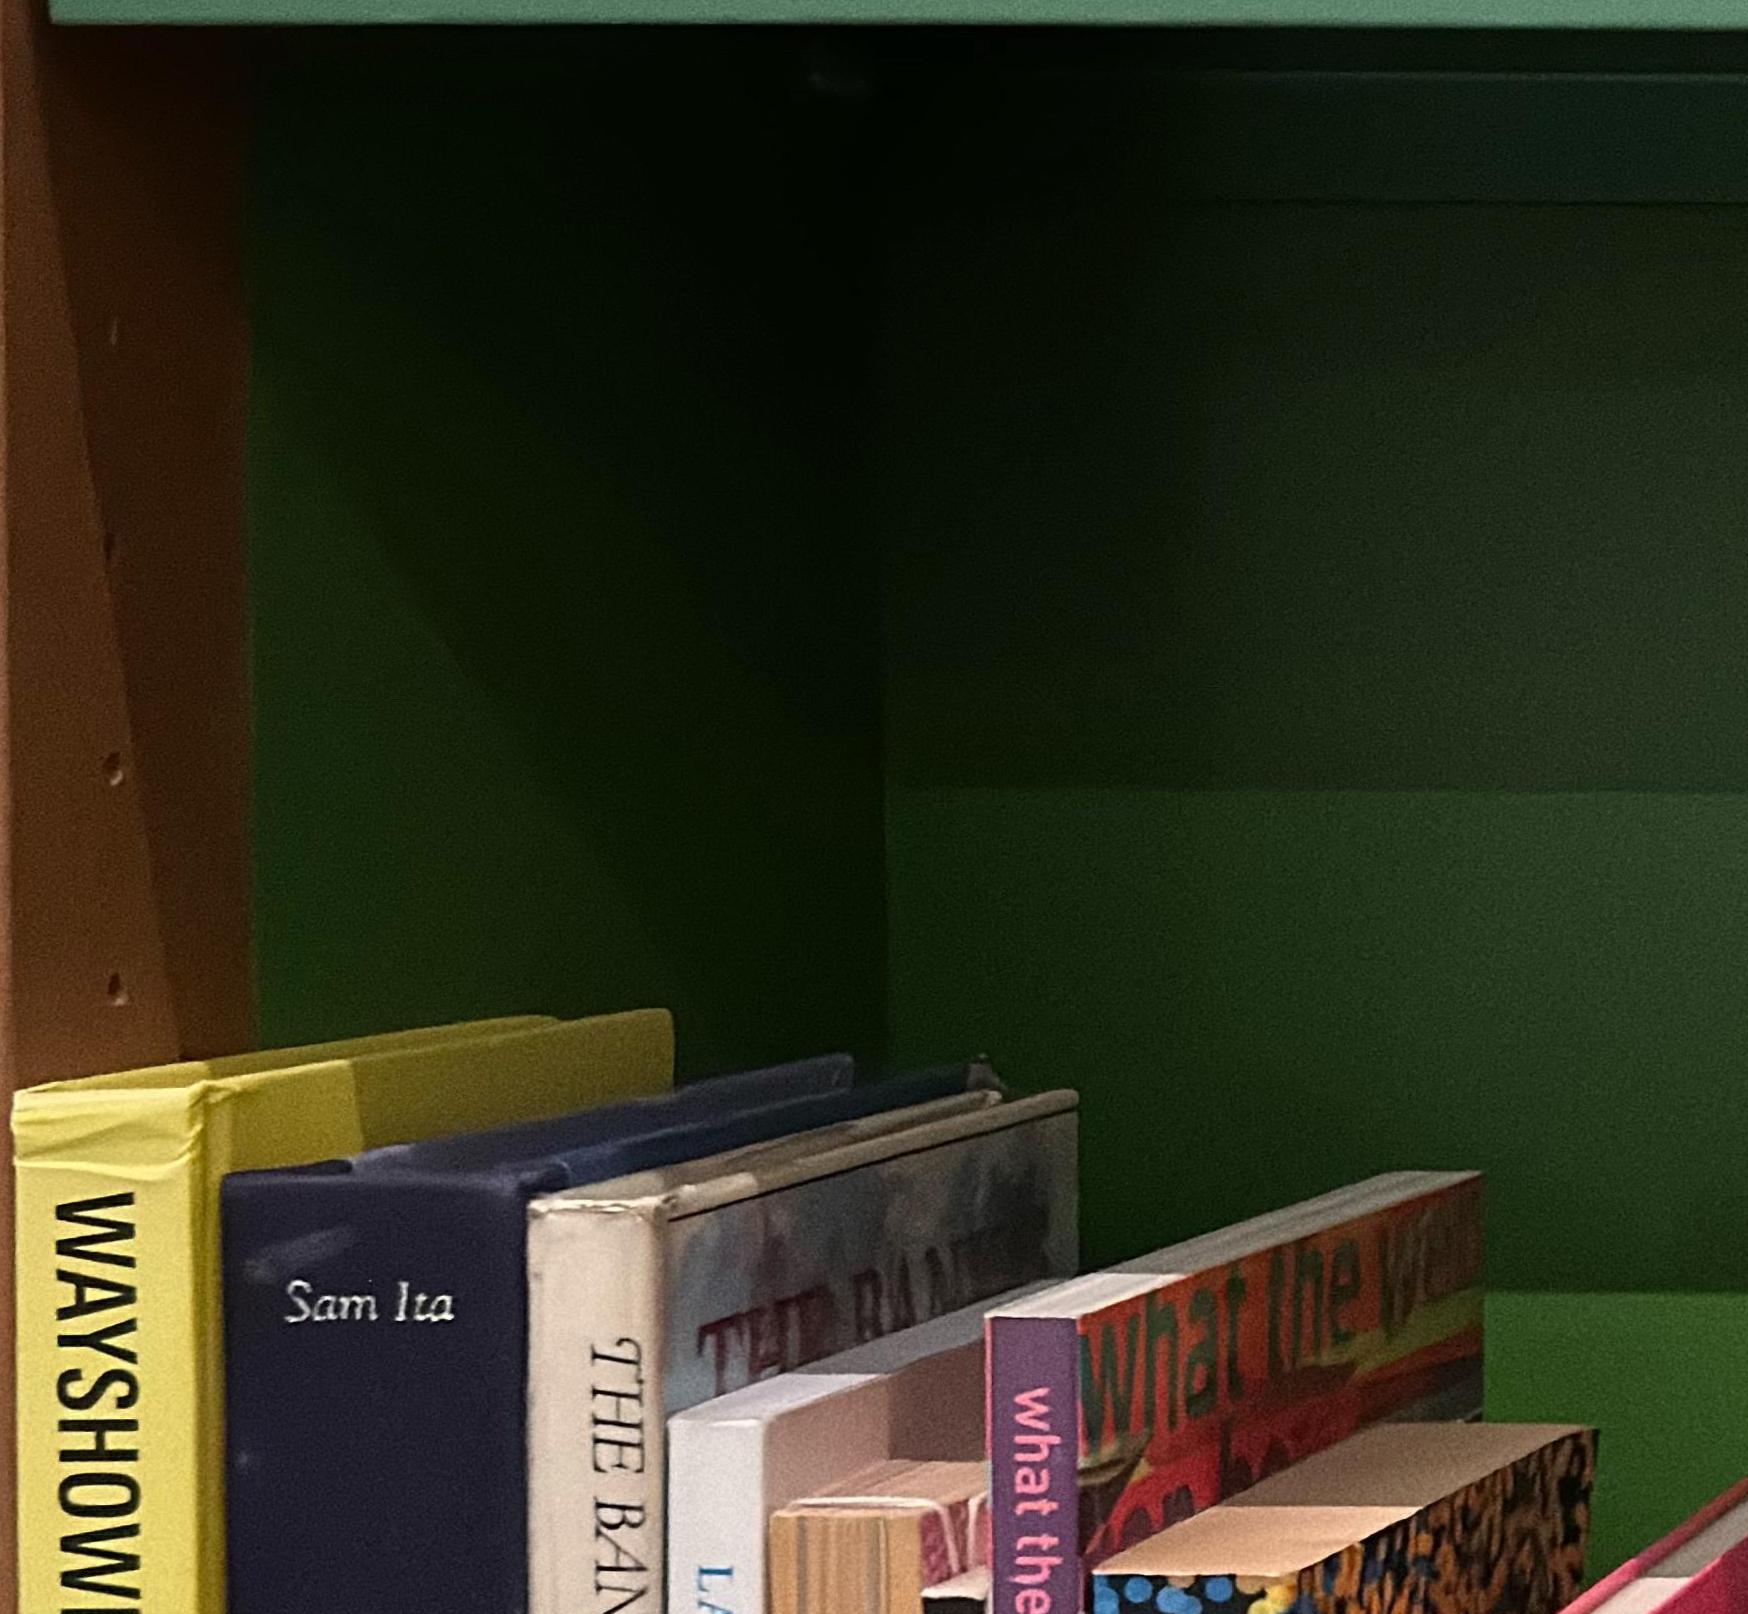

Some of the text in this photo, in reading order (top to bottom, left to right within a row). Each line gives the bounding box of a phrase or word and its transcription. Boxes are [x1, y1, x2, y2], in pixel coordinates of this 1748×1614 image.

[284, 1280, 455, 1323] Sam Ita
[590, 1337, 647, 1475] THE
[1013, 1387, 1061, 1521] what
